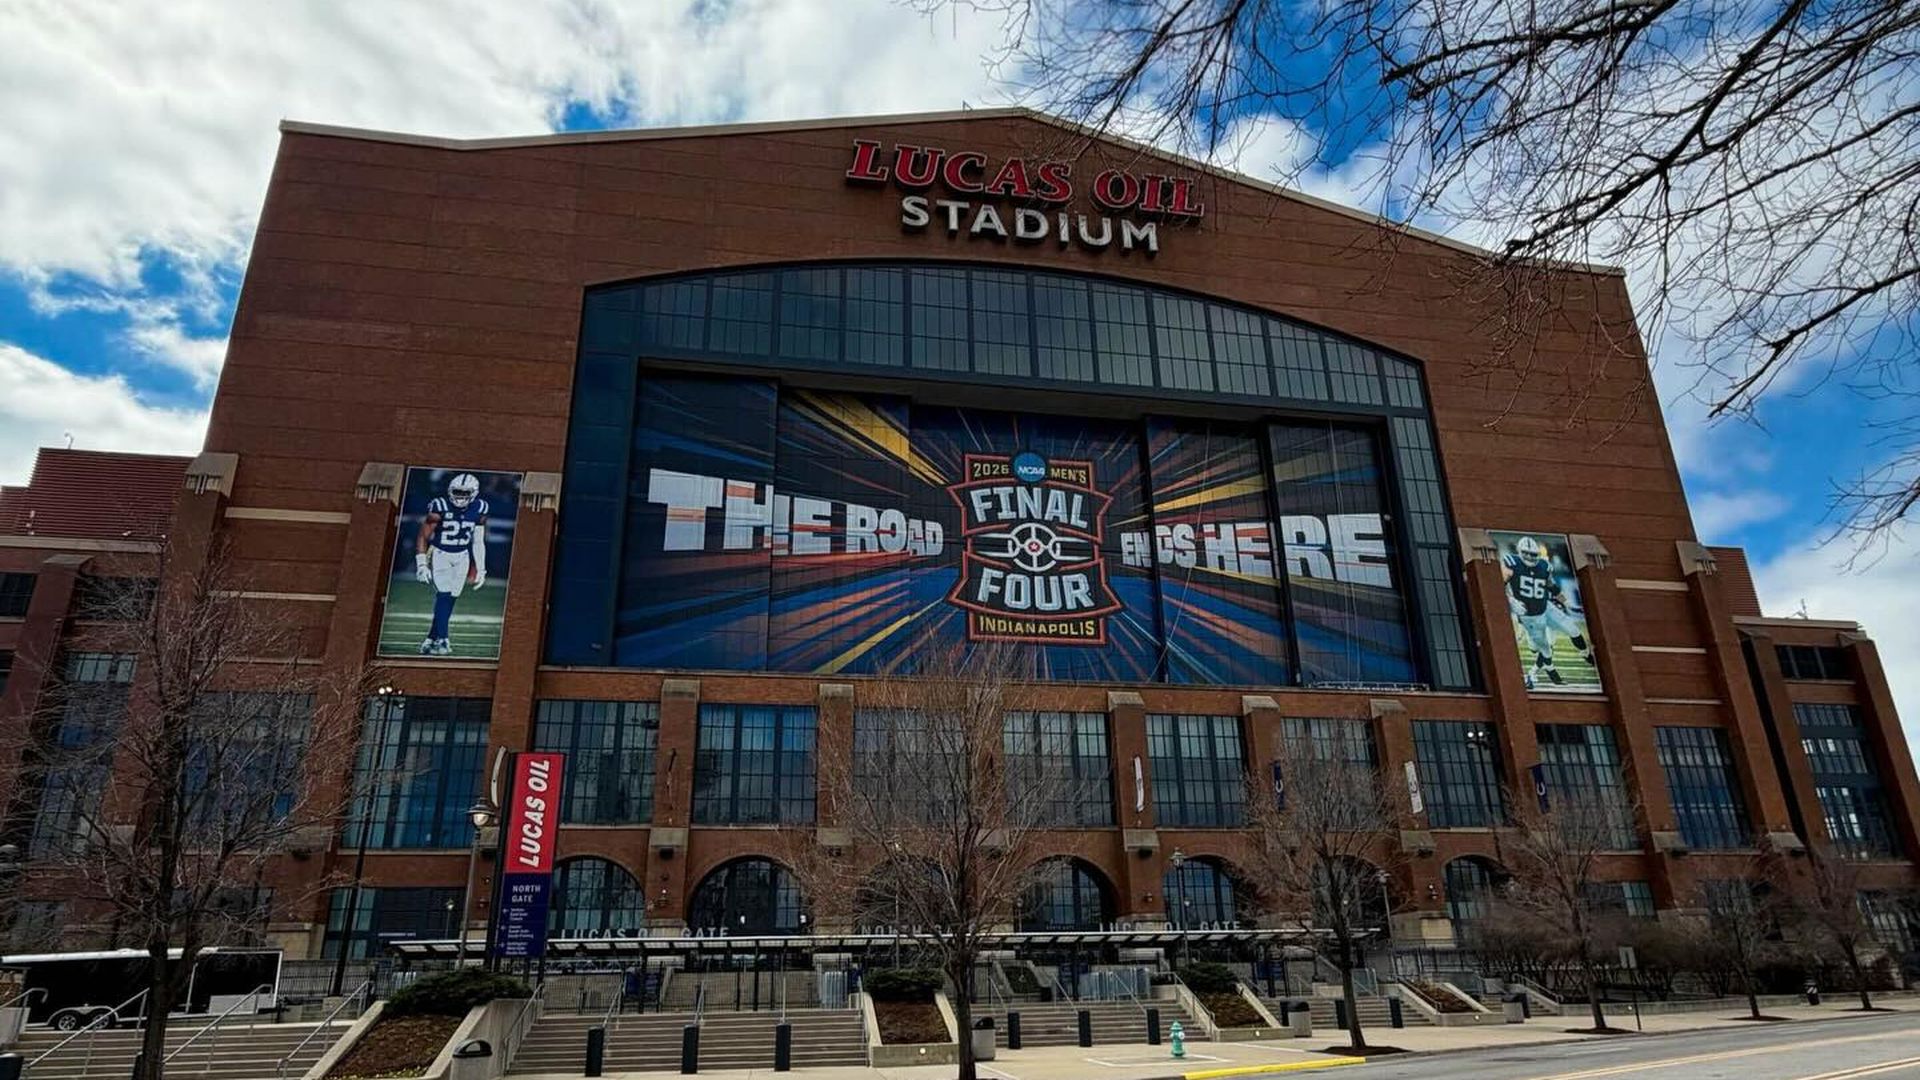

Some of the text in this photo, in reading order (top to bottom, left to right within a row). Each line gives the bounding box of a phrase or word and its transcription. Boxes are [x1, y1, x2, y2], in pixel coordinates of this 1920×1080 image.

[846, 139, 1205, 217] LUCAS OIL
[901, 196, 1160, 253] STADIUM
[973, 462, 1009, 478] 2026
[1051, 468, 1087, 484] MEN'S
[648, 467, 944, 557] THE ROAD
[970, 486, 1089, 529] FINAL
[440, 520, 475, 546] 23
[1120, 513, 1393, 589] ENDS HERE
[977, 566, 1095, 611] FOUR
[1519, 575, 1547, 600] 56
[979, 615, 1095, 636] INDIANAPOLIS
[519, 759, 550, 868] LUCAS OIL
[511, 894, 533, 903] GATE
[512, 884, 541, 893] NORTH
[681, 927, 729, 939] GATE
[1200, 921, 1241, 931] GATE
